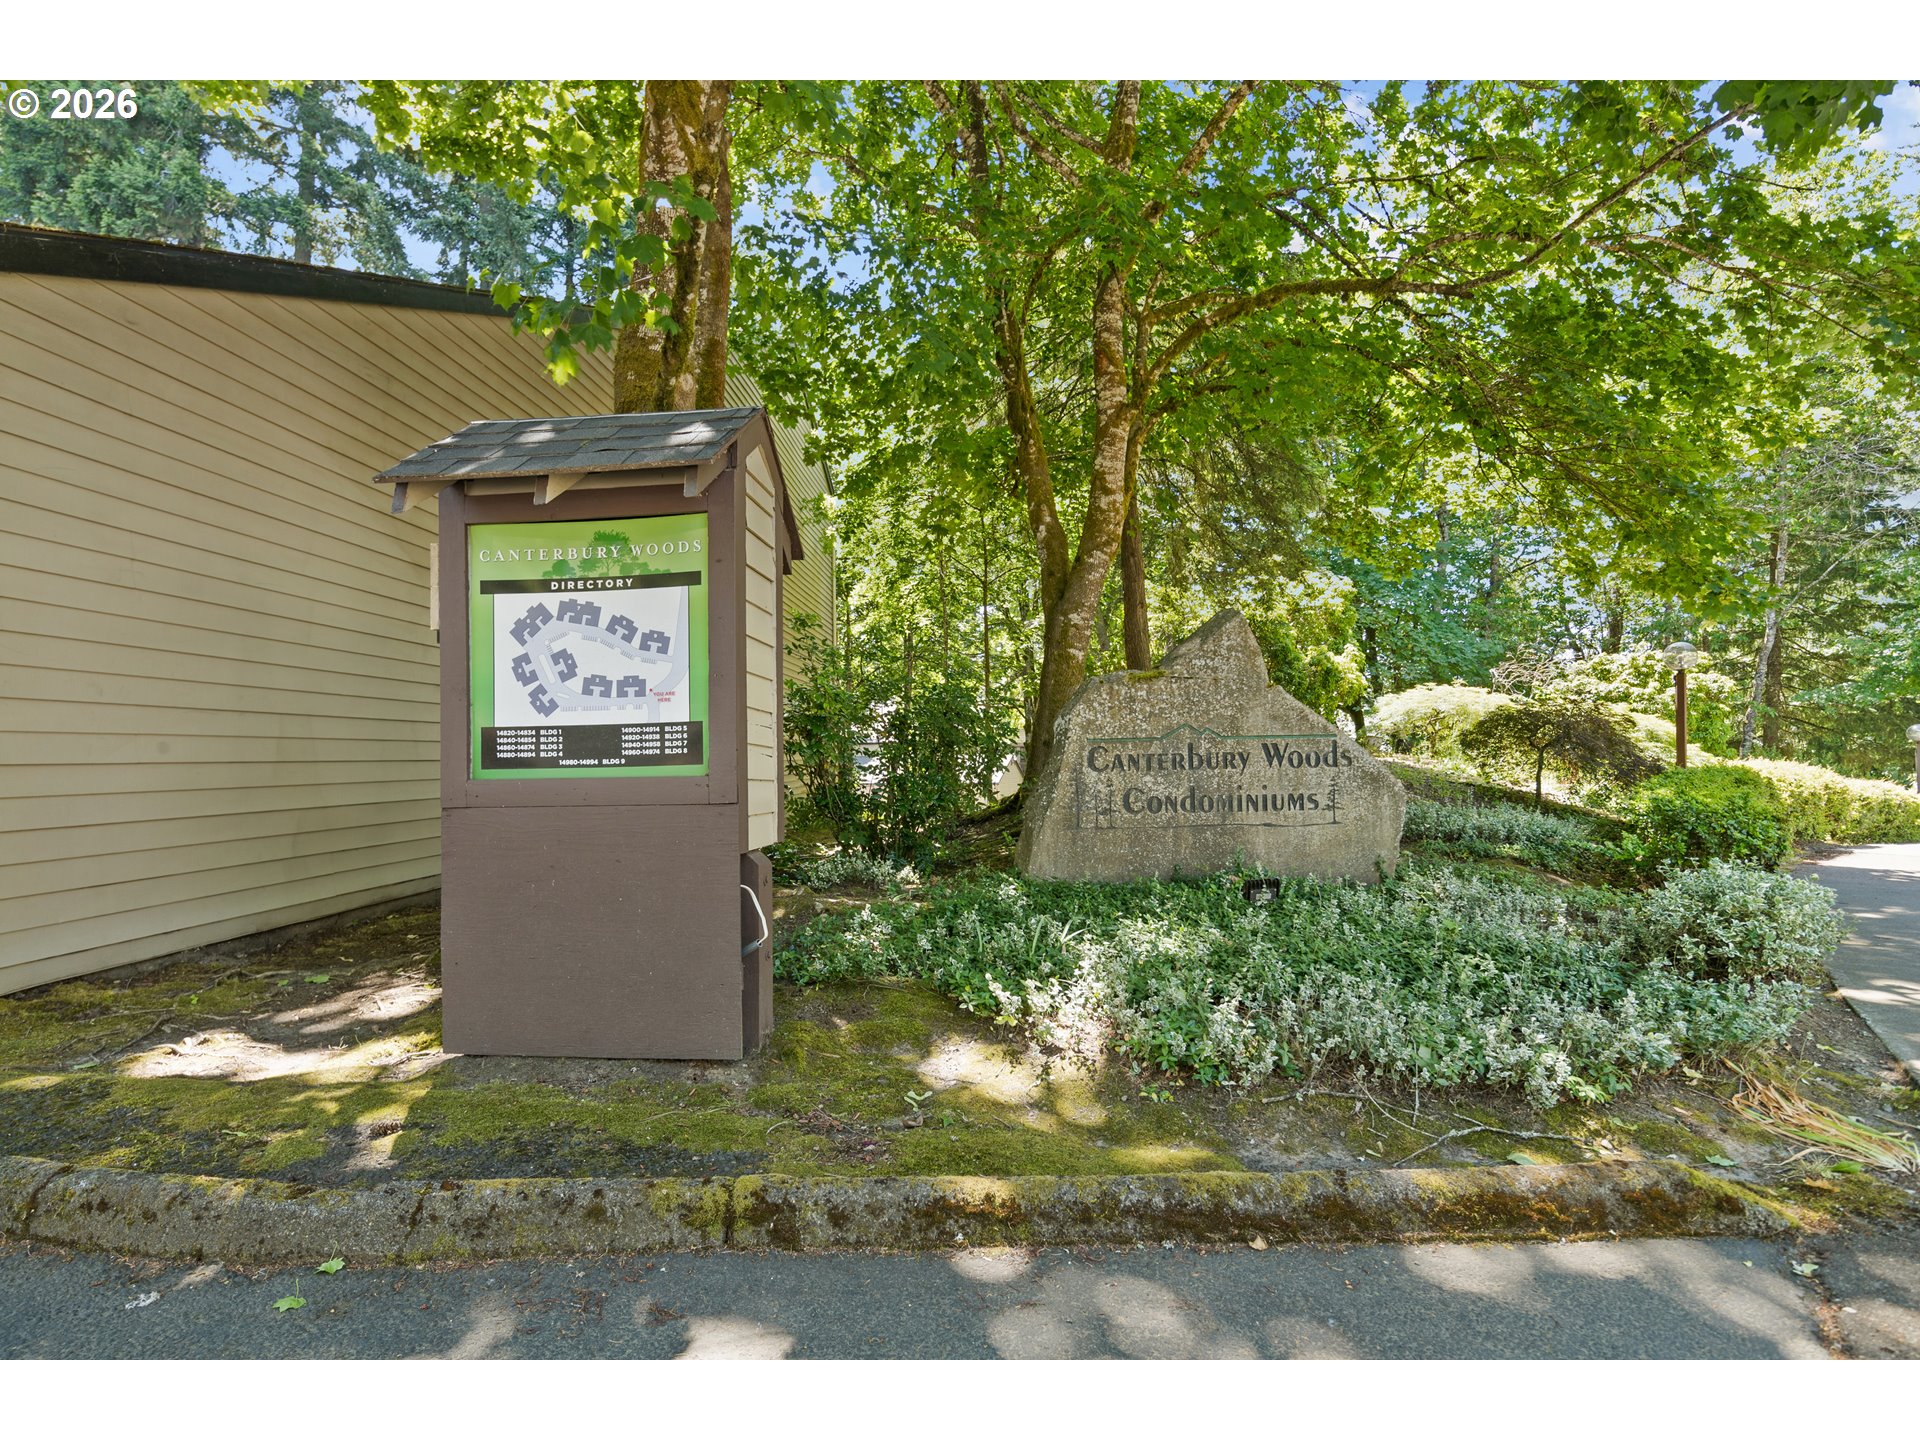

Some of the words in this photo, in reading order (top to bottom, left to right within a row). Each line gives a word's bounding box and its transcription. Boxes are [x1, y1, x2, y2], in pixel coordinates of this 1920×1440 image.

[479, 545, 621, 562] CANTERBURY
[629, 539, 702, 557] WOODS
[551, 578, 634, 591] DIRECTORY
